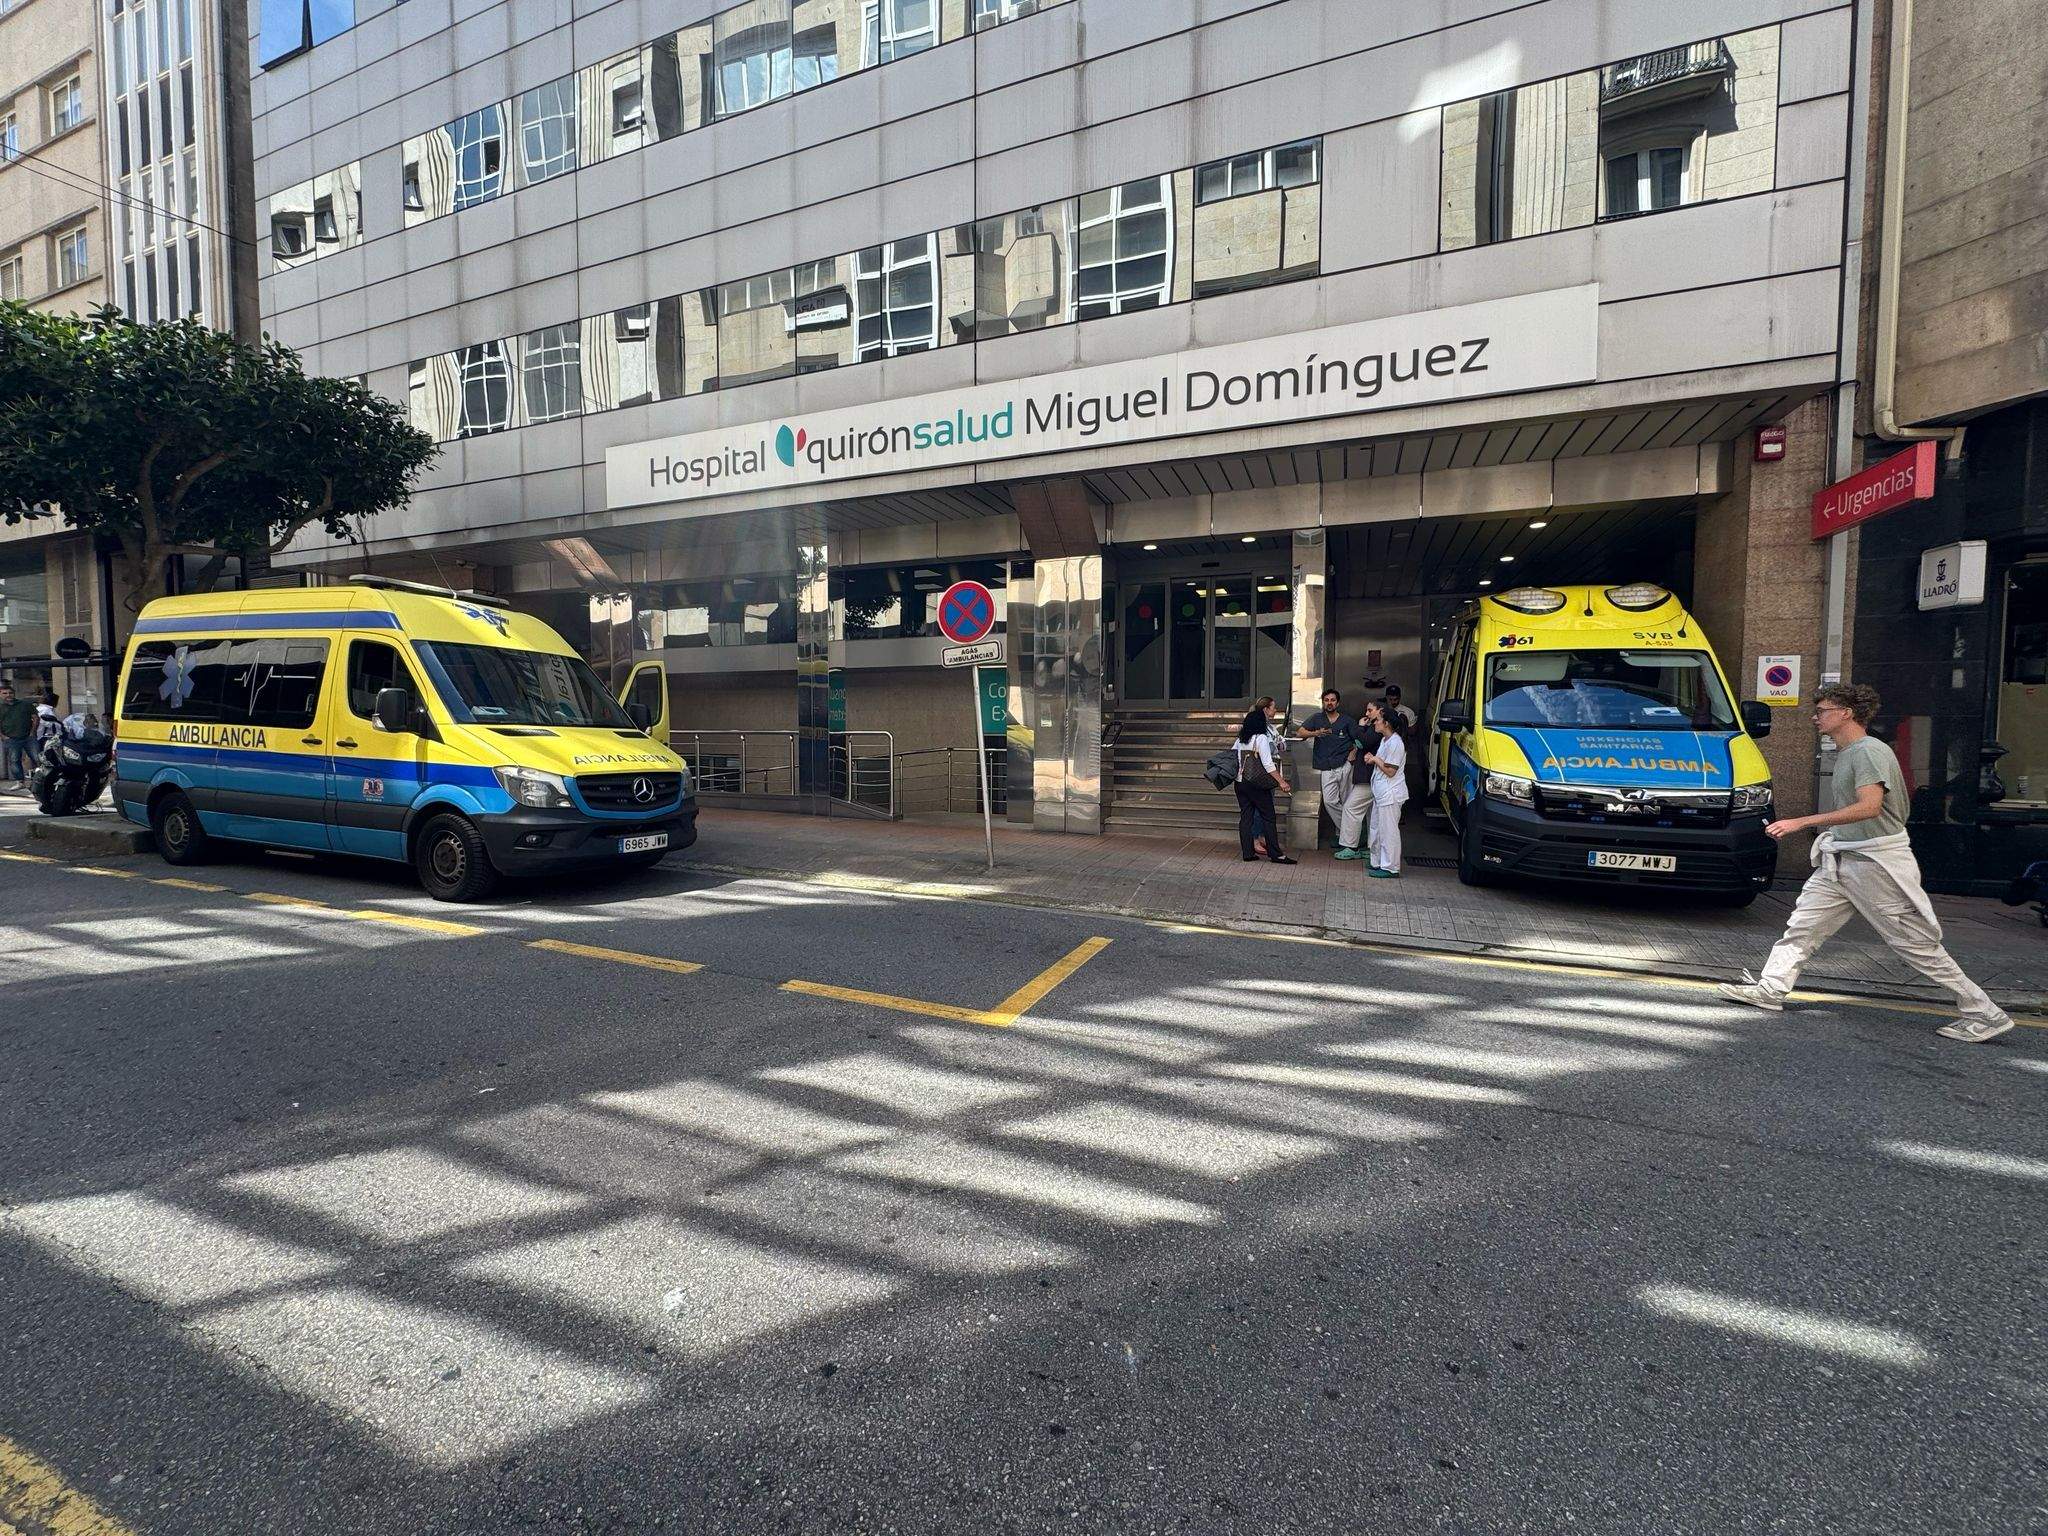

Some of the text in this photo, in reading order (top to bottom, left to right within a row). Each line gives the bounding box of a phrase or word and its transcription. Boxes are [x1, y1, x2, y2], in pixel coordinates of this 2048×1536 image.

[649, 337, 1490, 487] Hospital quirónsalud Miguel Domínguez
[1760, 430, 1784, 438] FUEGO
[1838, 466, 1914, 516] Urgencias
[1923, 579, 1958, 598] LLADRÓ
[1633, 632, 1673, 640] SVB
[948, 652, 994, 664] AMBULANCIAS
[169, 724, 267, 748] AMBULANCIA
[1607, 803, 1662, 815] MAN
[625, 838, 649, 850] 6965
[1599, 853, 1671, 869] 3077 MWJ
